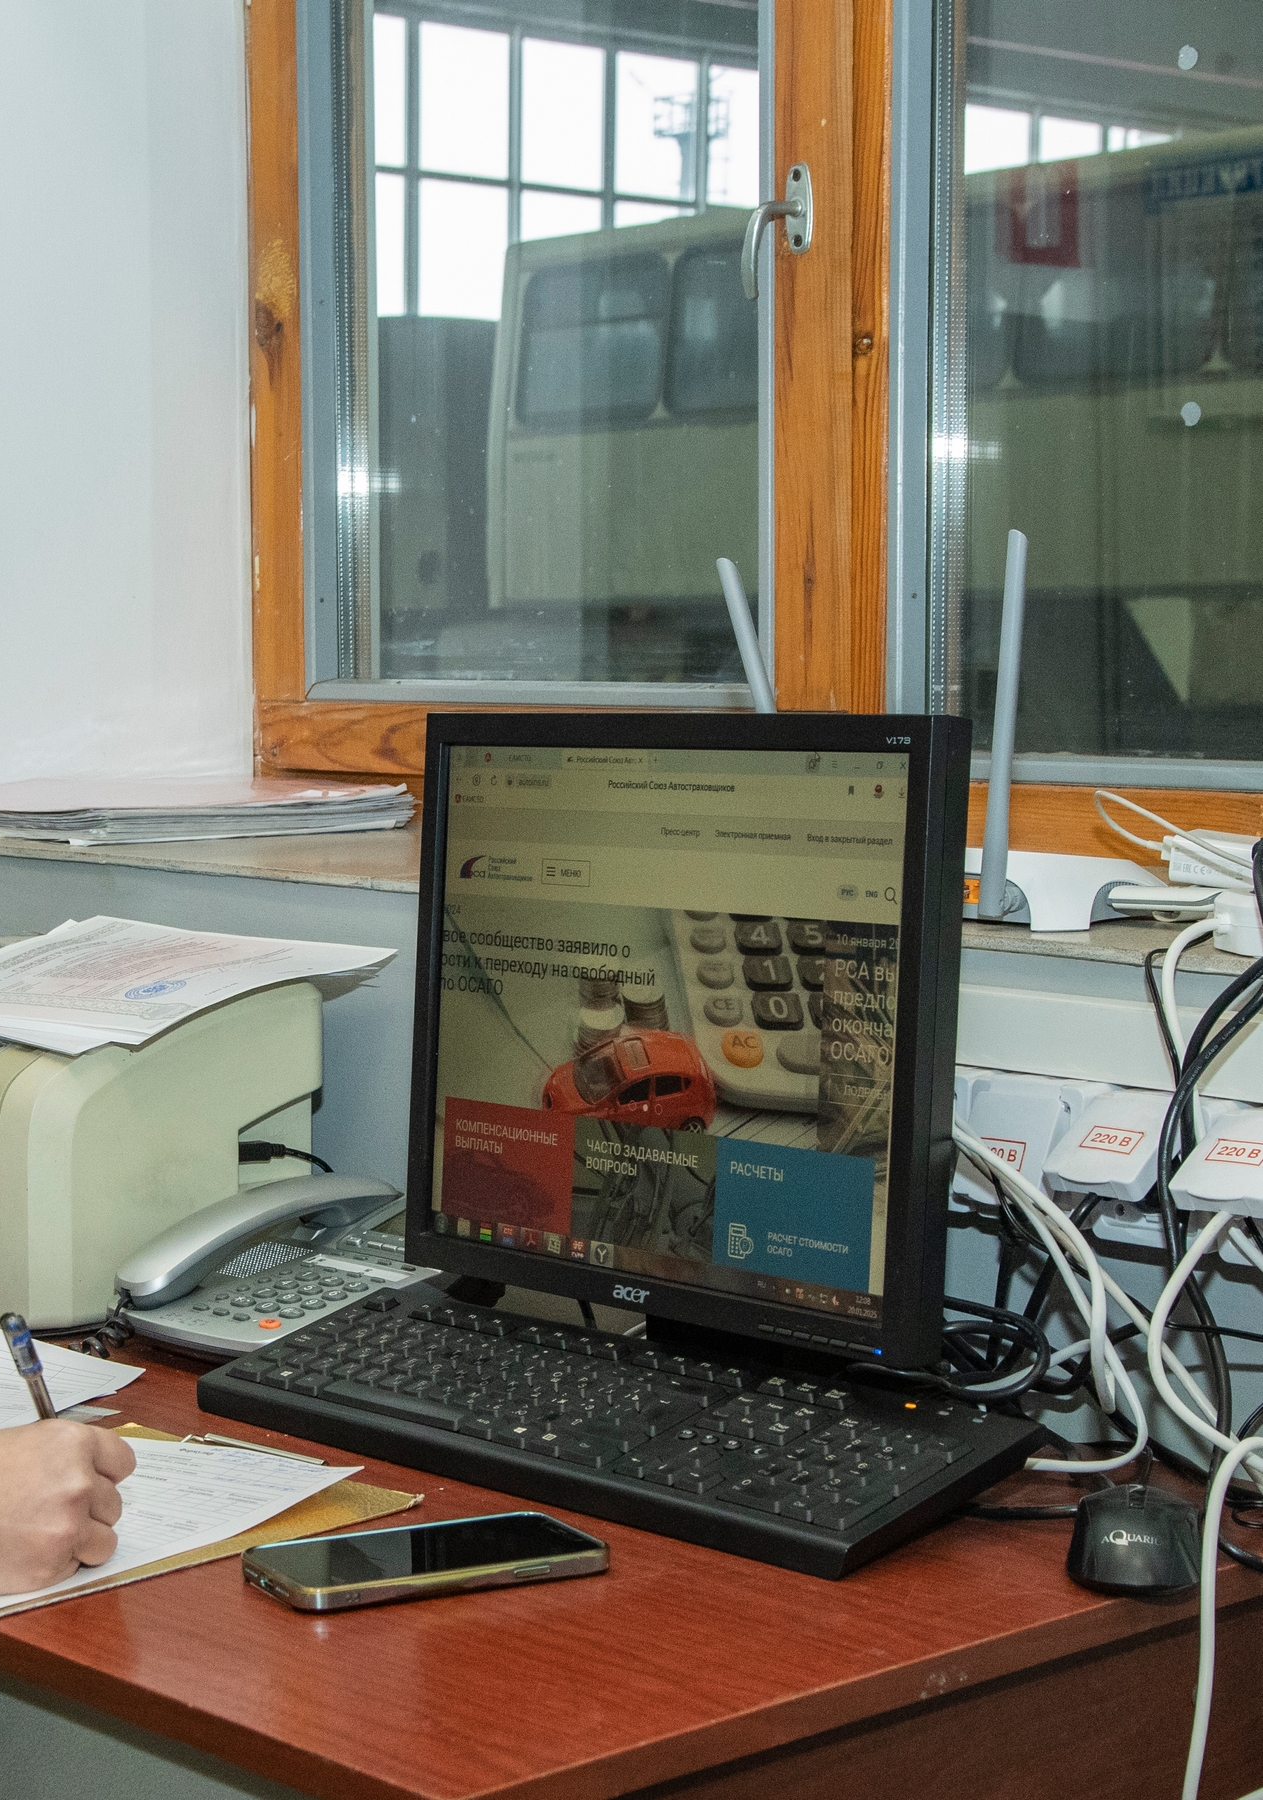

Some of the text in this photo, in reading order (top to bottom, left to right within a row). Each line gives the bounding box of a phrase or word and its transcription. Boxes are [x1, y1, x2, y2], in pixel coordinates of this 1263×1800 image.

[608, 780, 735, 793] Российский Союз Автостраховщиков
[661, 827, 700, 838] Пресс-центр
[715, 829, 791, 841] Электронная приемная
[807, 833, 824, 844] Вход
[830, 835, 866, 846] закрытый
[867, 836, 893, 846] раздел
[560, 869, 582, 878] МЕНЮ
[841, 888, 854, 897] РУС
[865, 890, 878, 898] ENG
[443, 929, 630, 958] вое сообщество заявило о
[750, 925, 770, 945] 4
[804, 923, 823, 944] 5
[836, 933, 848, 945] 10
[850, 936, 886, 950] января
[475, 956, 483, 970] к
[486, 957, 549, 980] переходу
[552, 963, 569, 978] на
[572, 964, 656, 987] свободный
[762, 959, 777, 981] 1
[834, 959, 870, 980] РСА
[458, 975, 504, 996] ОСАГО
[769, 996, 789, 1019] 0
[832, 990, 896, 1012] предло
[832, 1018, 894, 1038] оконча
[731, 1035, 756, 1049] AC
[830, 1041, 889, 1065] ОСАГО
[455, 1118, 558, 1146] КОМПЕНСАЦИОННЫЕ
[1090, 1132, 1133, 1148] 220 В
[455, 1136, 503, 1155] ВЫПЛАТЫ
[587, 1138, 698, 1169] ЧАСТО ЗАДАВАЕМЫЕ
[1217, 1146, 1262, 1159] 220 В
[586, 1156, 637, 1176] ВОПРОСЫ
[730, 1161, 784, 1182] РАСЧЕТЫ
[767, 1245, 793, 1258] ОСАГО
[768, 1231, 849, 1255] РАСЧЕТ СТОИМОСТИ
[613, 1284, 650, 1303] acer
[1101, 1529, 1159, 1546] AQUARI
